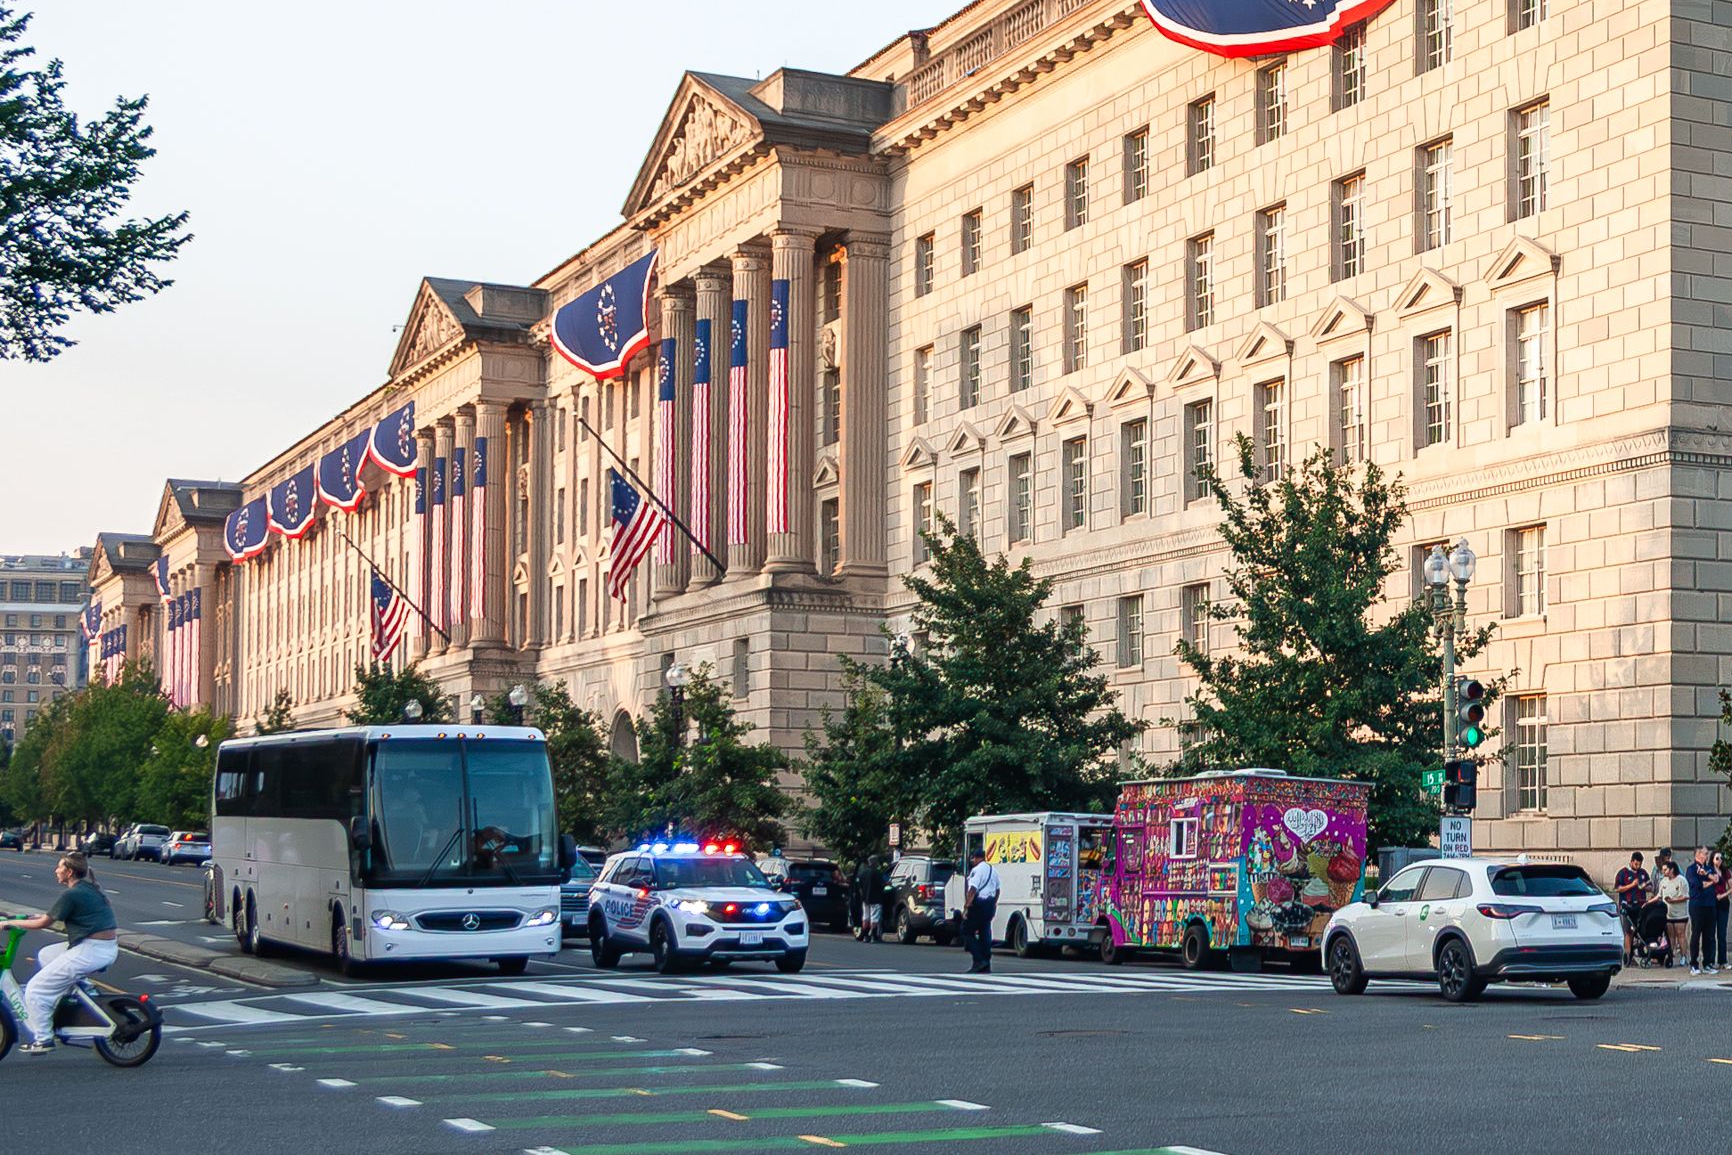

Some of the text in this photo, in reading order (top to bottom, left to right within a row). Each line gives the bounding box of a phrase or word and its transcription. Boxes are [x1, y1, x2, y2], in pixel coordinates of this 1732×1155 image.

[1427, 773, 1435, 785] 15
[1450, 821, 1462, 831] NO
[1445, 832, 1467, 842] TURN
[1443, 844, 1469, 853] ON RED
[605, 899, 634, 917] POLICE
